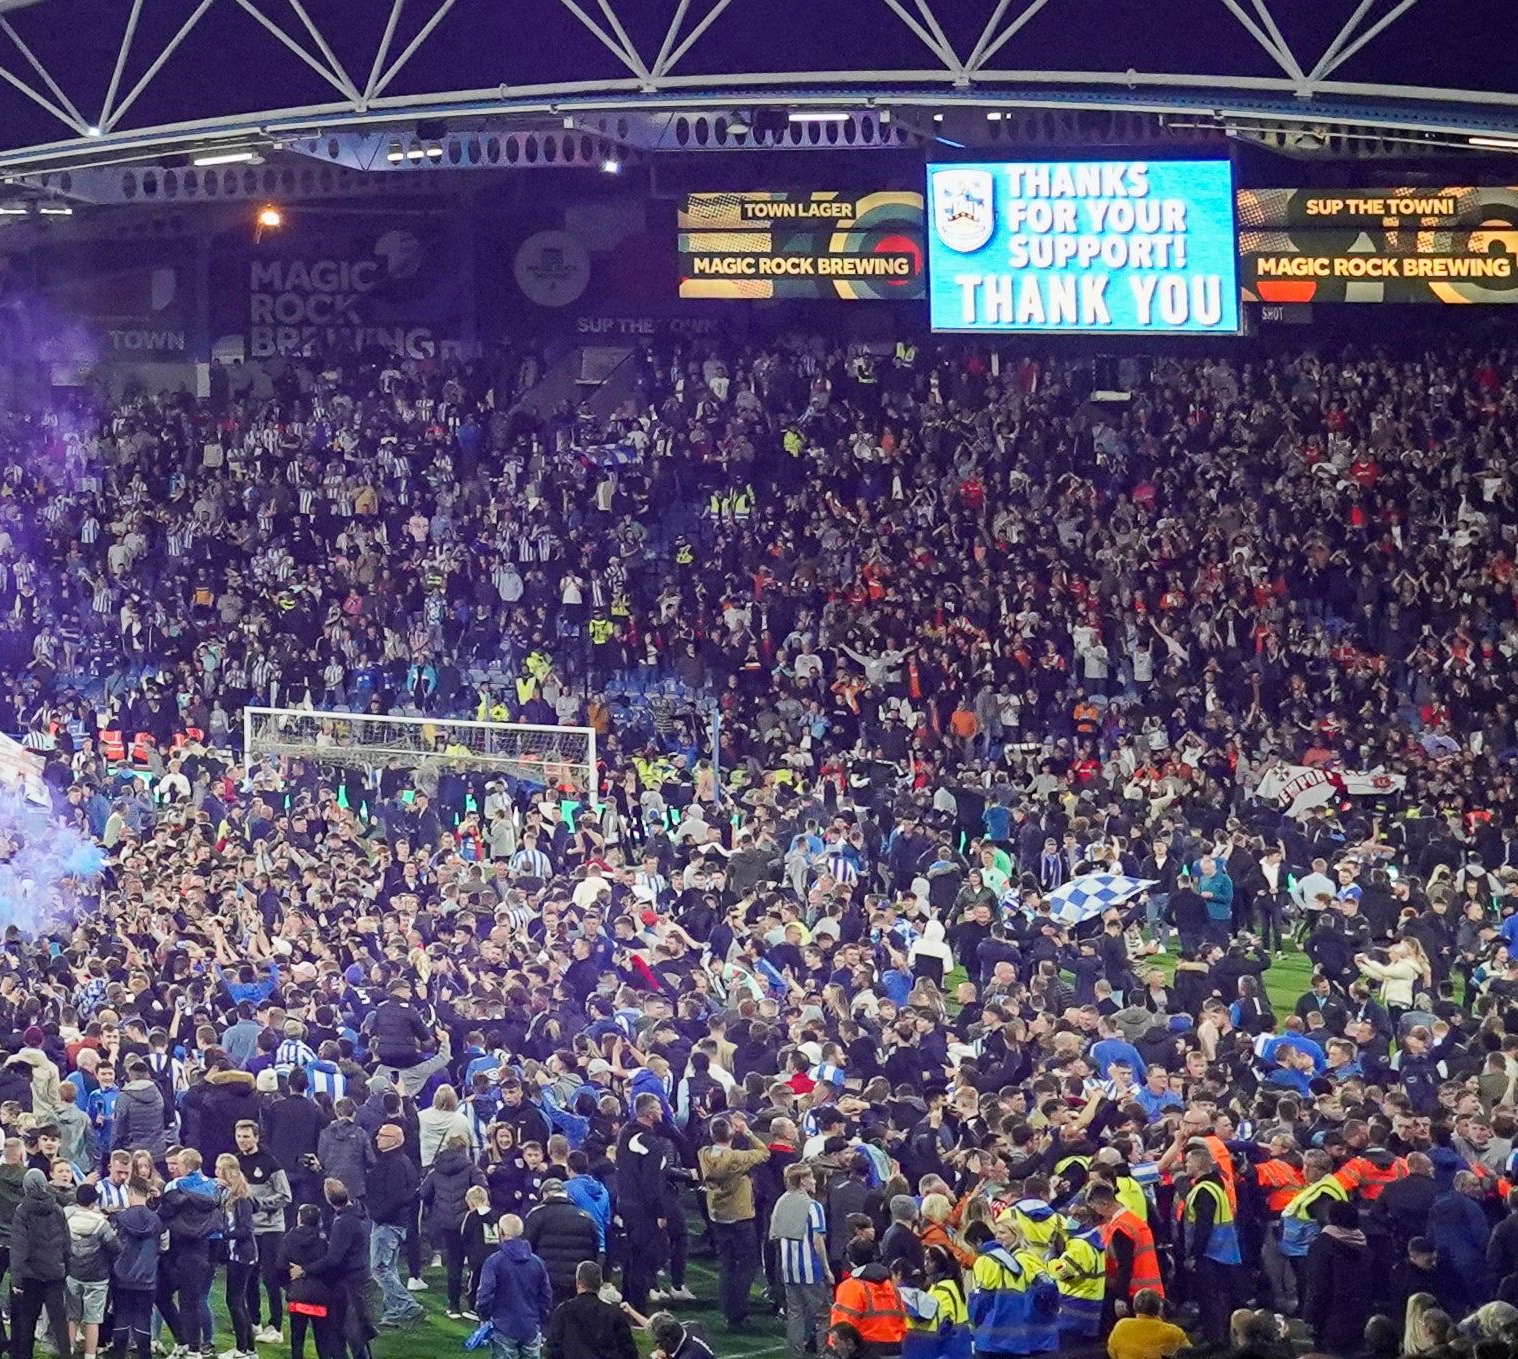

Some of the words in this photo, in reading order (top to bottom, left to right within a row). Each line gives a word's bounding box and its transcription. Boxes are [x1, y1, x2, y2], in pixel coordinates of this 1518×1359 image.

[1005, 163, 1150, 199] THANKS
[744, 202, 797, 218] TOWN
[798, 202, 854, 218] LAGER
[1007, 199, 1078, 234] FOR
[1084, 198, 1188, 234] YOUR
[1305, 198, 1345, 216] SUP
[1345, 199, 1385, 215] THE
[1386, 198, 1455, 215] TOWN!
[1008, 234, 1188, 269] SUPPORT!
[250, 259, 379, 293] MAGIC
[693, 256, 756, 275] MAGIC
[758, 256, 815, 275] ROCK
[817, 257, 910, 276] BREWING
[1256, 257, 1331, 277] MAGIC
[1333, 257, 1400, 277] ROCK
[1403, 258, 1512, 277] BREWING
[250, 292, 363, 325] ROCK
[954, 273, 1113, 325] THANK
[1127, 273, 1223, 326] YOU
[576, 317, 615, 334] SUP
[619, 317, 655, 334] THE
[667, 317, 718, 334] OWN
[108, 329, 185, 351] TOWN
